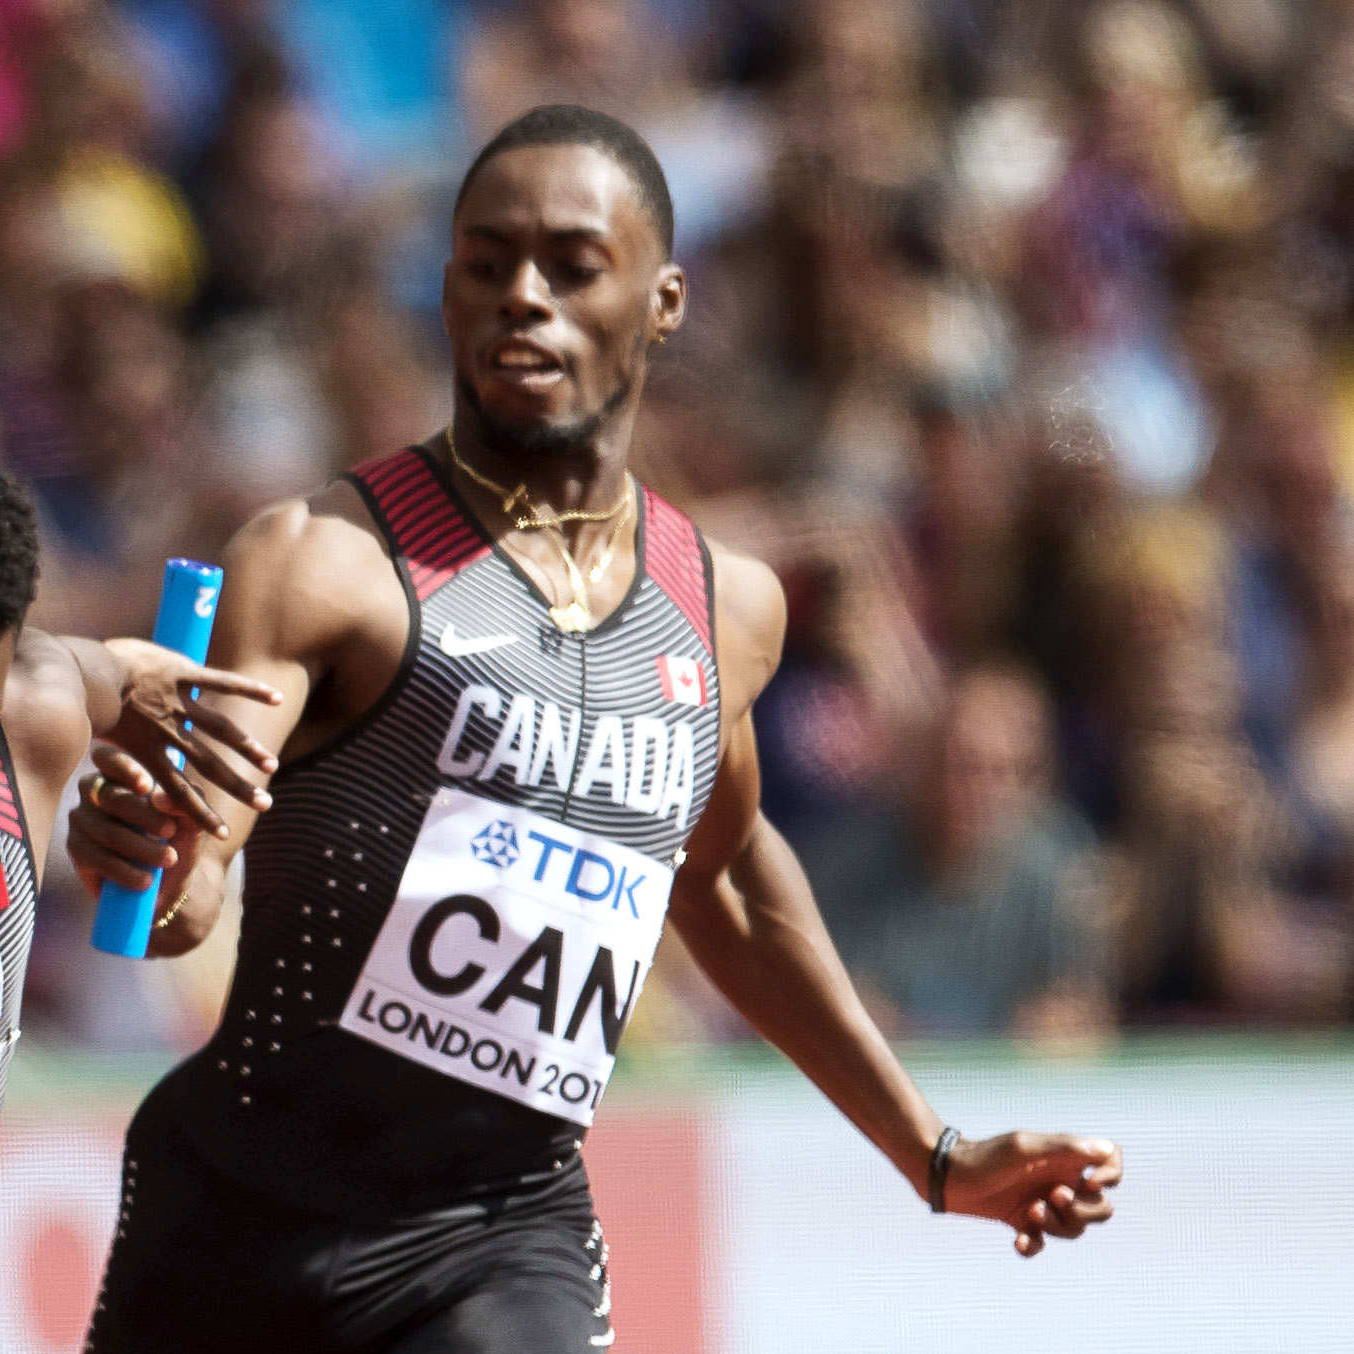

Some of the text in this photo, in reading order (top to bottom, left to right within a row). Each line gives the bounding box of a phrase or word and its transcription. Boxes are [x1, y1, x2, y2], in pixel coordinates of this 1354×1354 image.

[194, 586, 216, 618] 2
[435, 684, 695, 830] CANADA
[528, 830, 647, 919] TDK
[408, 894, 641, 1056] CAN
[358, 989, 602, 1111] LONDON 201
